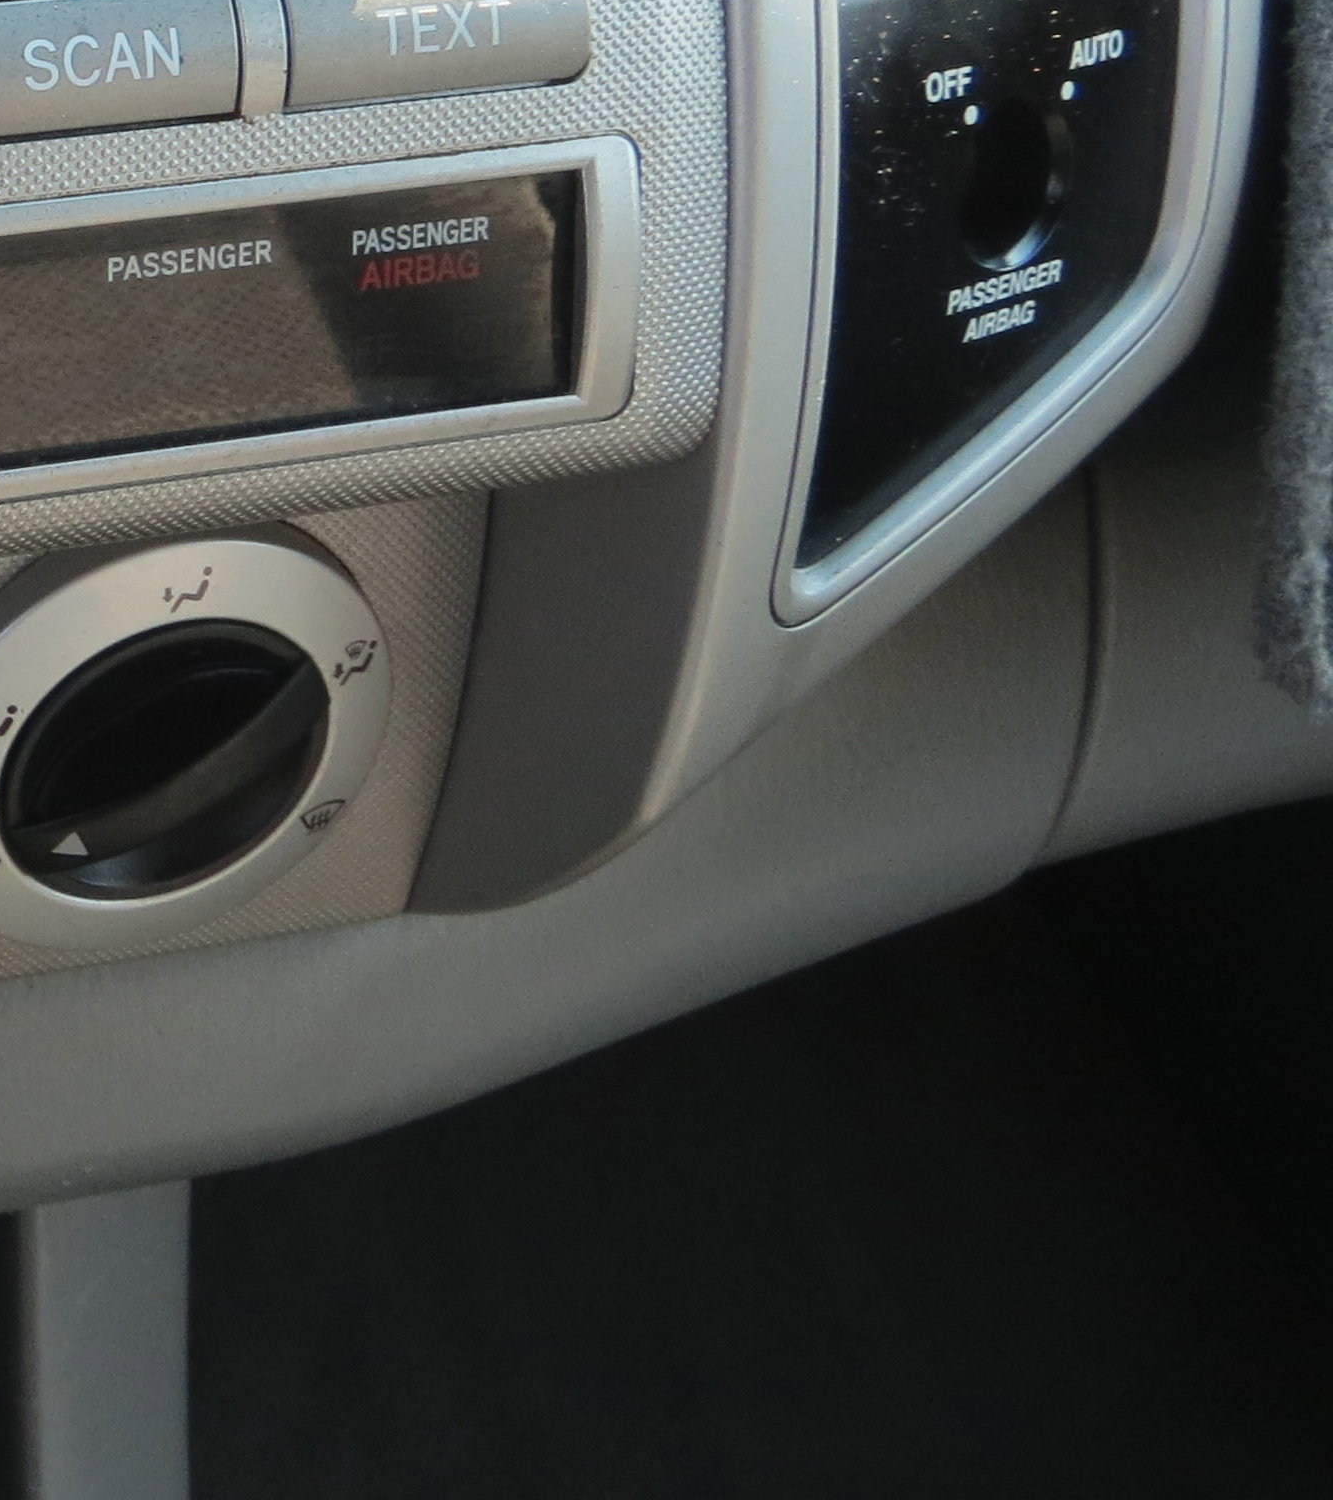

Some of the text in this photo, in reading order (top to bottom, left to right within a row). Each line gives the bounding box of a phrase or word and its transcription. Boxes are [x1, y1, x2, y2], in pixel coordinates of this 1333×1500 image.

[21, 27, 184, 92] SCAN
[1069, 29, 1125, 71] AUTO
[924, 65, 974, 103] OFF
[351, 215, 490, 257] PASSENGER
[106, 239, 273, 283] PASSENGER
[358, 249, 482, 292] AIRBAG
[945, 258, 1064, 316] PASSENGER
[962, 300, 1037, 344] AIRBAG
